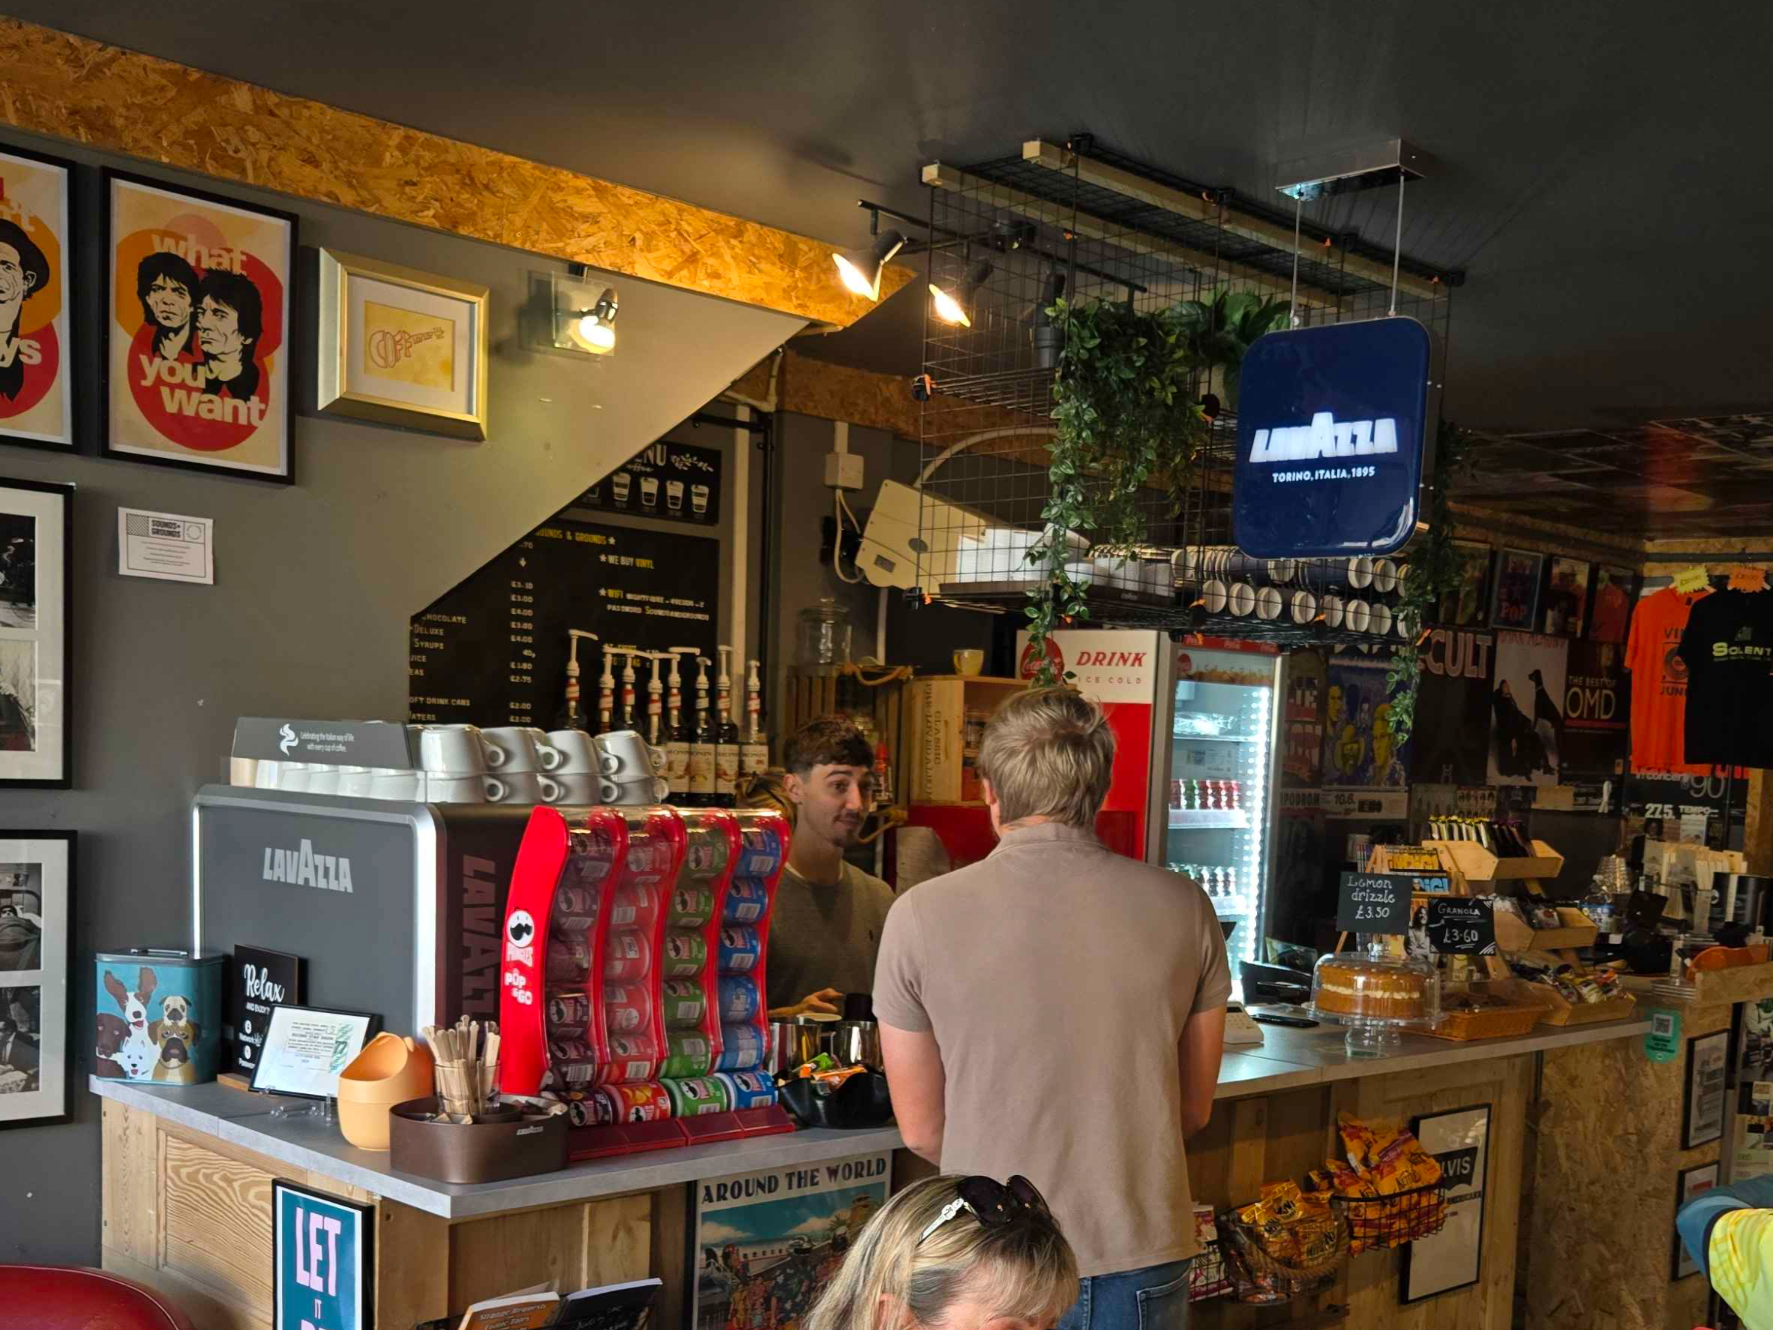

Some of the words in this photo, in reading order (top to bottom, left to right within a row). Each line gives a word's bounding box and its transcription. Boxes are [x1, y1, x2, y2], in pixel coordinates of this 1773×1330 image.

[152, 234, 247, 275] what
[139, 354, 207, 389] you
[160, 386, 266, 428] want
[1249, 411, 1398, 463] LAVAZZA
[1272, 470, 1314, 484] TORINO,
[1315, 468, 1352, 481] ITALIA,
[1352, 466, 1375, 479] 1895
[566, 531, 573, 541] &
[607, 555, 620, 565] WE
[620, 556, 634, 567] BUY
[1076, 651, 1148, 668] DRINK
[1427, 629, 1493, 681] CULT
[410, 668, 425, 676] EAS
[1108, 676, 1144, 685] COLD
[410, 696, 425, 704] OFT
[1565, 686, 1617, 721] OMD
[262, 838, 354, 894] LAVAZZA
[1346, 875, 1393, 890] Lemon
[1351, 887, 1396, 904] drizzle
[1355, 905, 1391, 920] £3.50
[462, 854, 502, 1022] LAVAZZ
[244, 963, 286, 1003] Relax
[505, 968, 527, 988] POP
[1442, 1157, 1471, 1178] LVIS
[702, 1174, 780, 1205] AROUND
[785, 1168, 821, 1191] THE
[826, 1157, 887, 1183] WORLD
[295, 1206, 342, 1298] LET
[315, 1298, 323, 1320] IT
